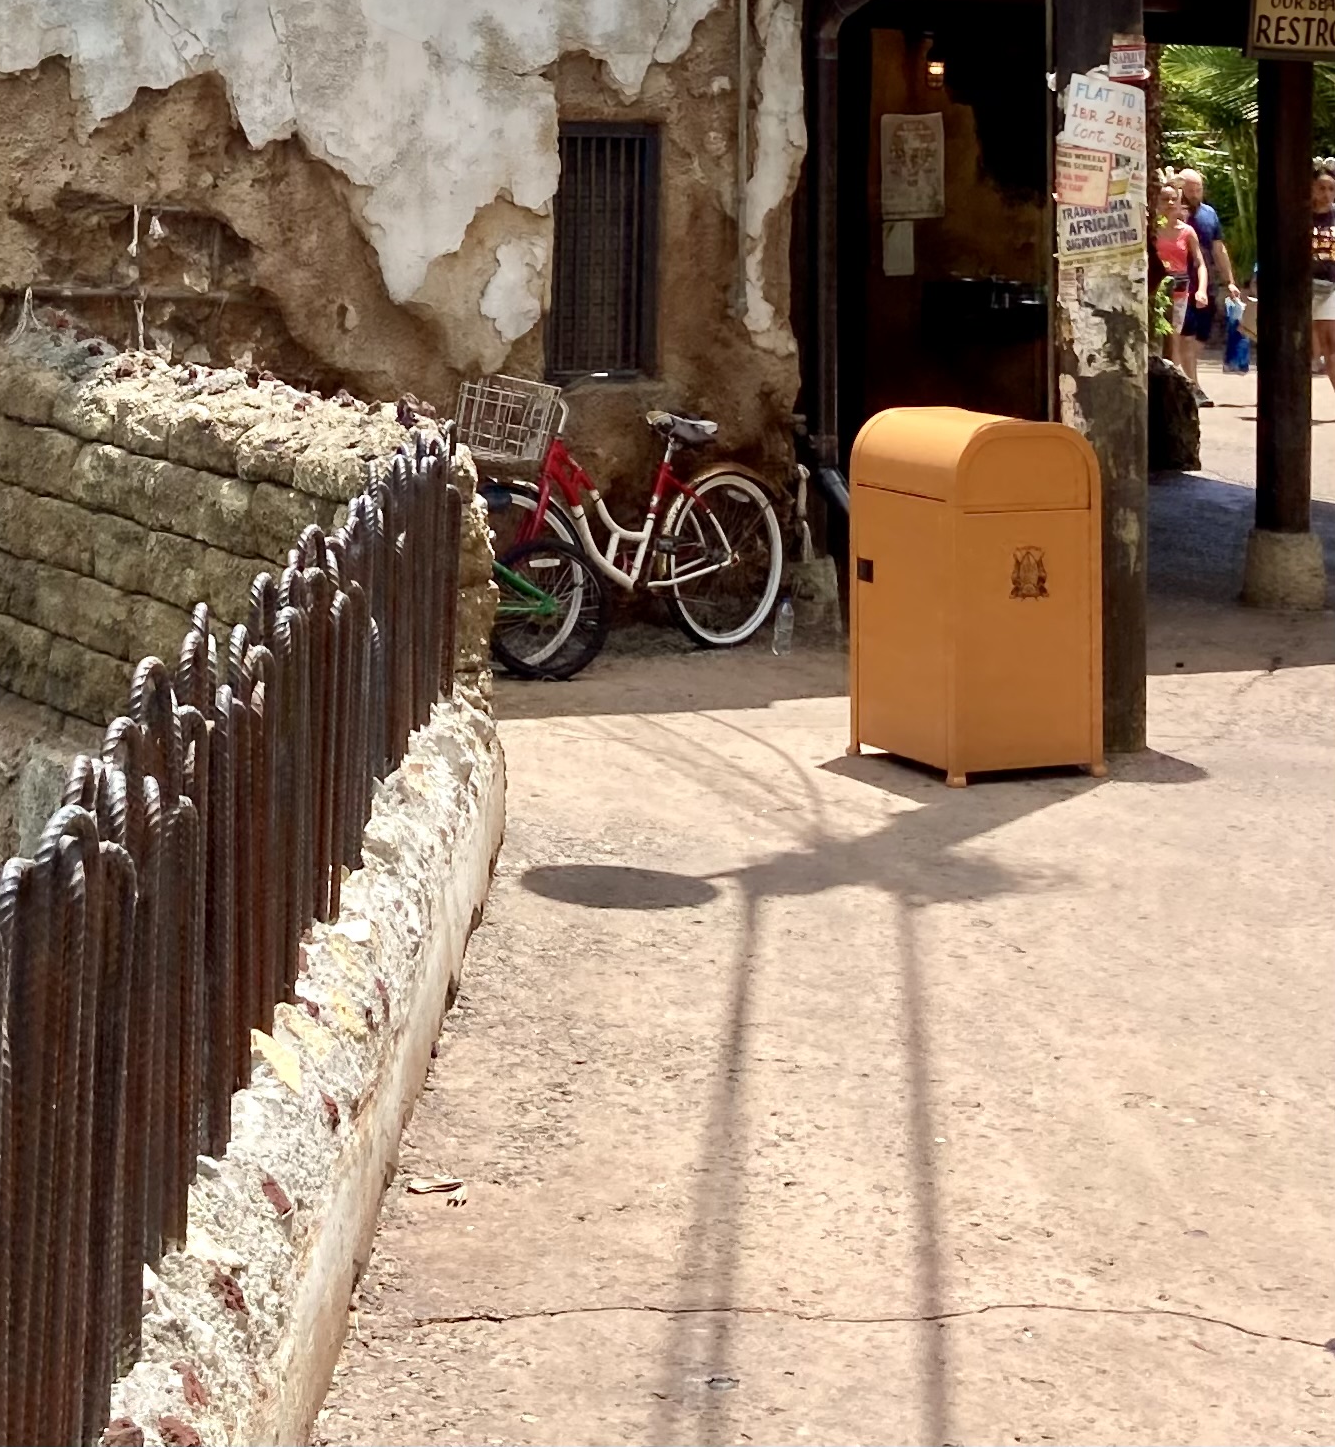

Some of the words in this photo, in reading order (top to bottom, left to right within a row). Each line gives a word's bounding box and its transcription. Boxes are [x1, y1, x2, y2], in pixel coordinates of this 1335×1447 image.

[1075, 82, 1115, 102] FLAT
[1122, 91, 1136, 108] TO
[1069, 212, 1130, 236] AFRICAN
[1065, 228, 1138, 252] SIGNWRITING
